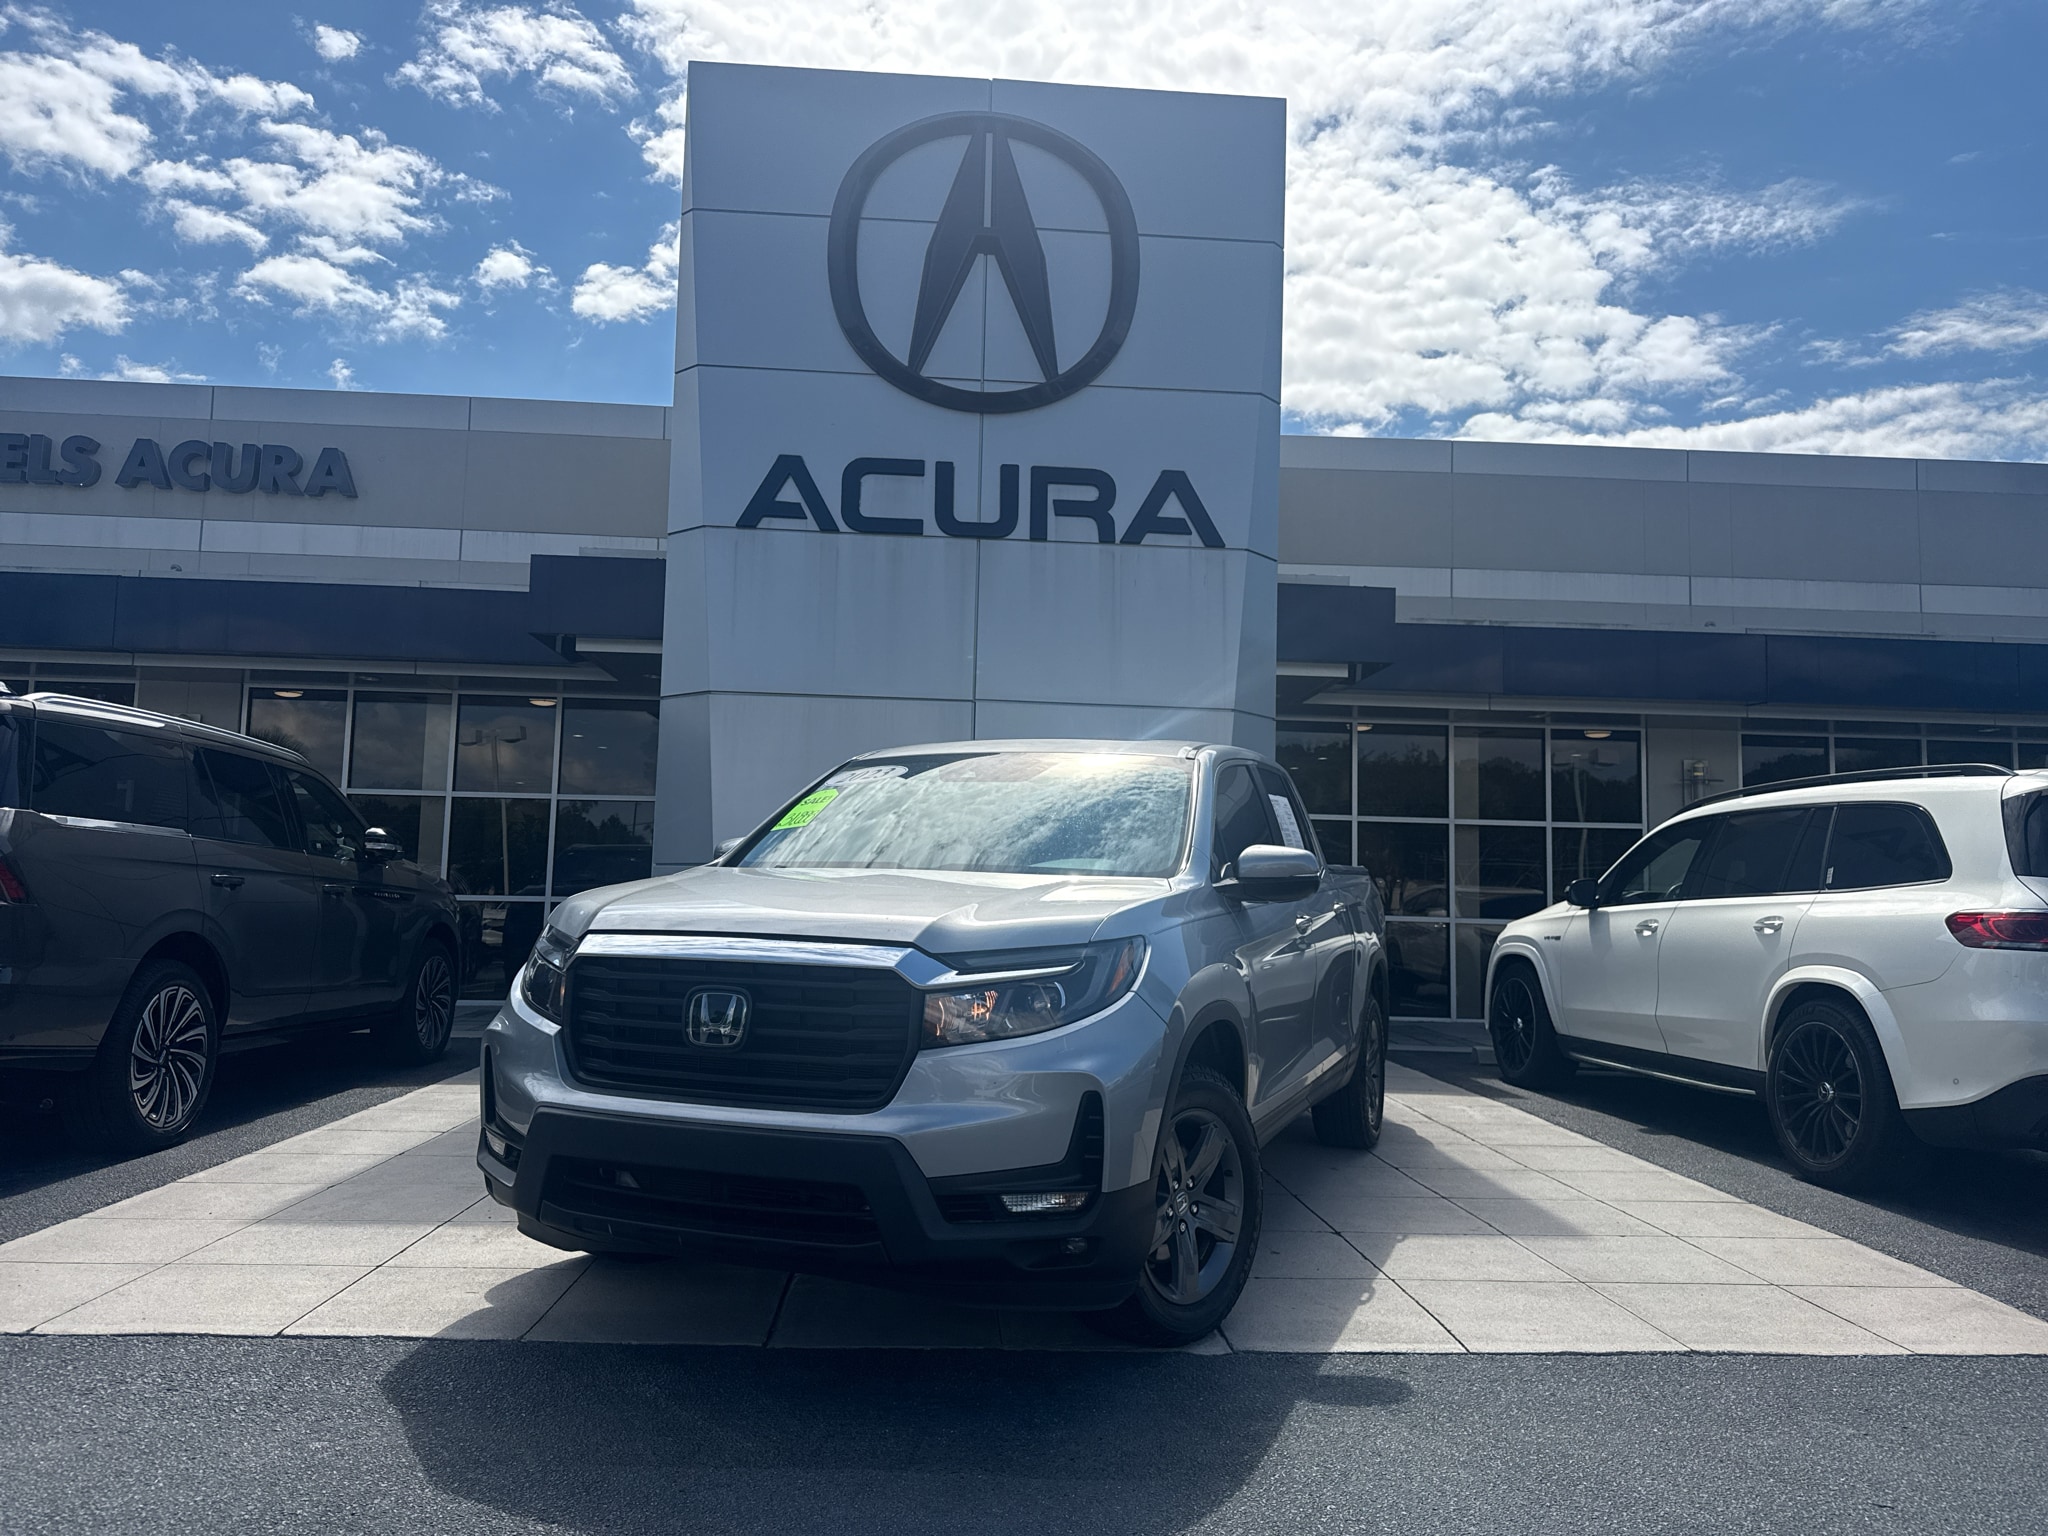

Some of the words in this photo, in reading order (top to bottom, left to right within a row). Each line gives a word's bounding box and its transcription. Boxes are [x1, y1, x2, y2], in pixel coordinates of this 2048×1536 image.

[0, 432, 102, 487] ELS
[115, 438, 358, 498] ACURA
[735, 454, 1226, 548] ACURA
